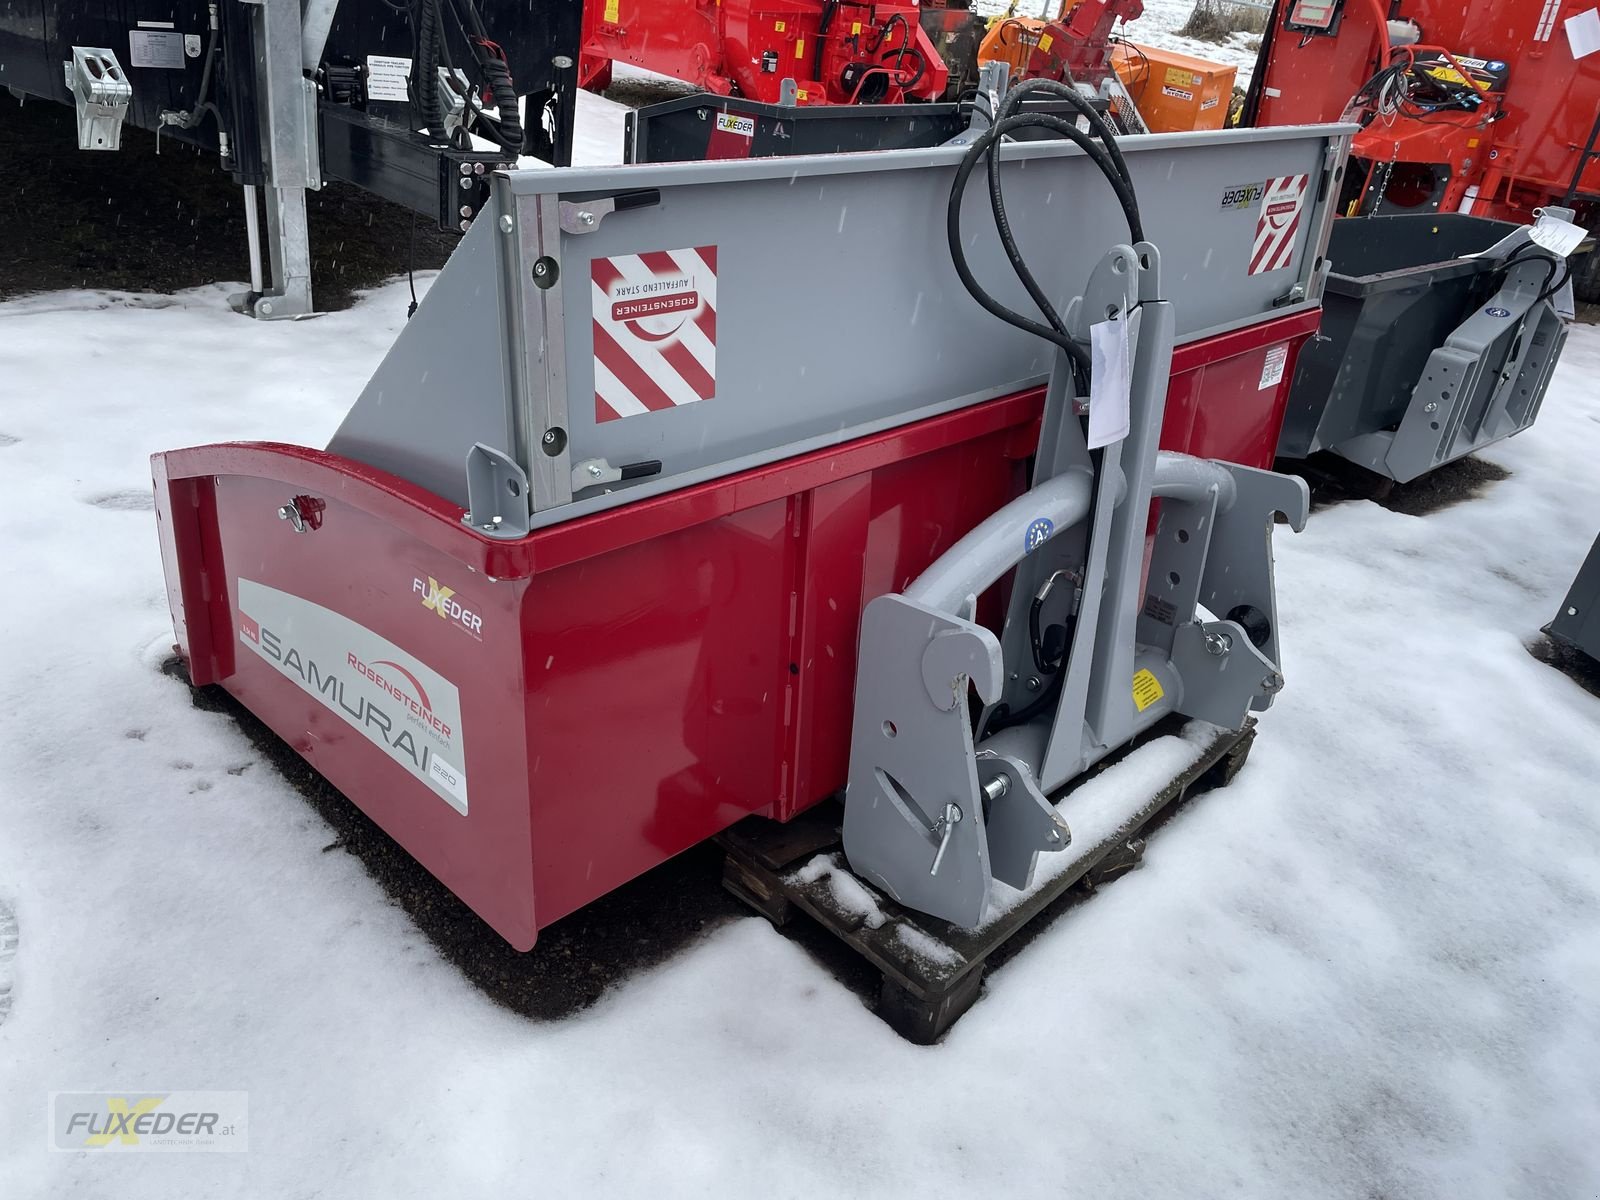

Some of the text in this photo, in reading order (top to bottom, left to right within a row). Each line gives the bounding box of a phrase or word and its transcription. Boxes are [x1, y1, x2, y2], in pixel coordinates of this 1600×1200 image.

[616, 279, 689, 296] AUFFALLEND STARK
[616, 297, 695, 316] ROSENSTEINER
[261, 627, 428, 772] SAMURAI
[347, 652, 451, 739] ROSENSTEINER
[432, 762, 457, 786] 220
